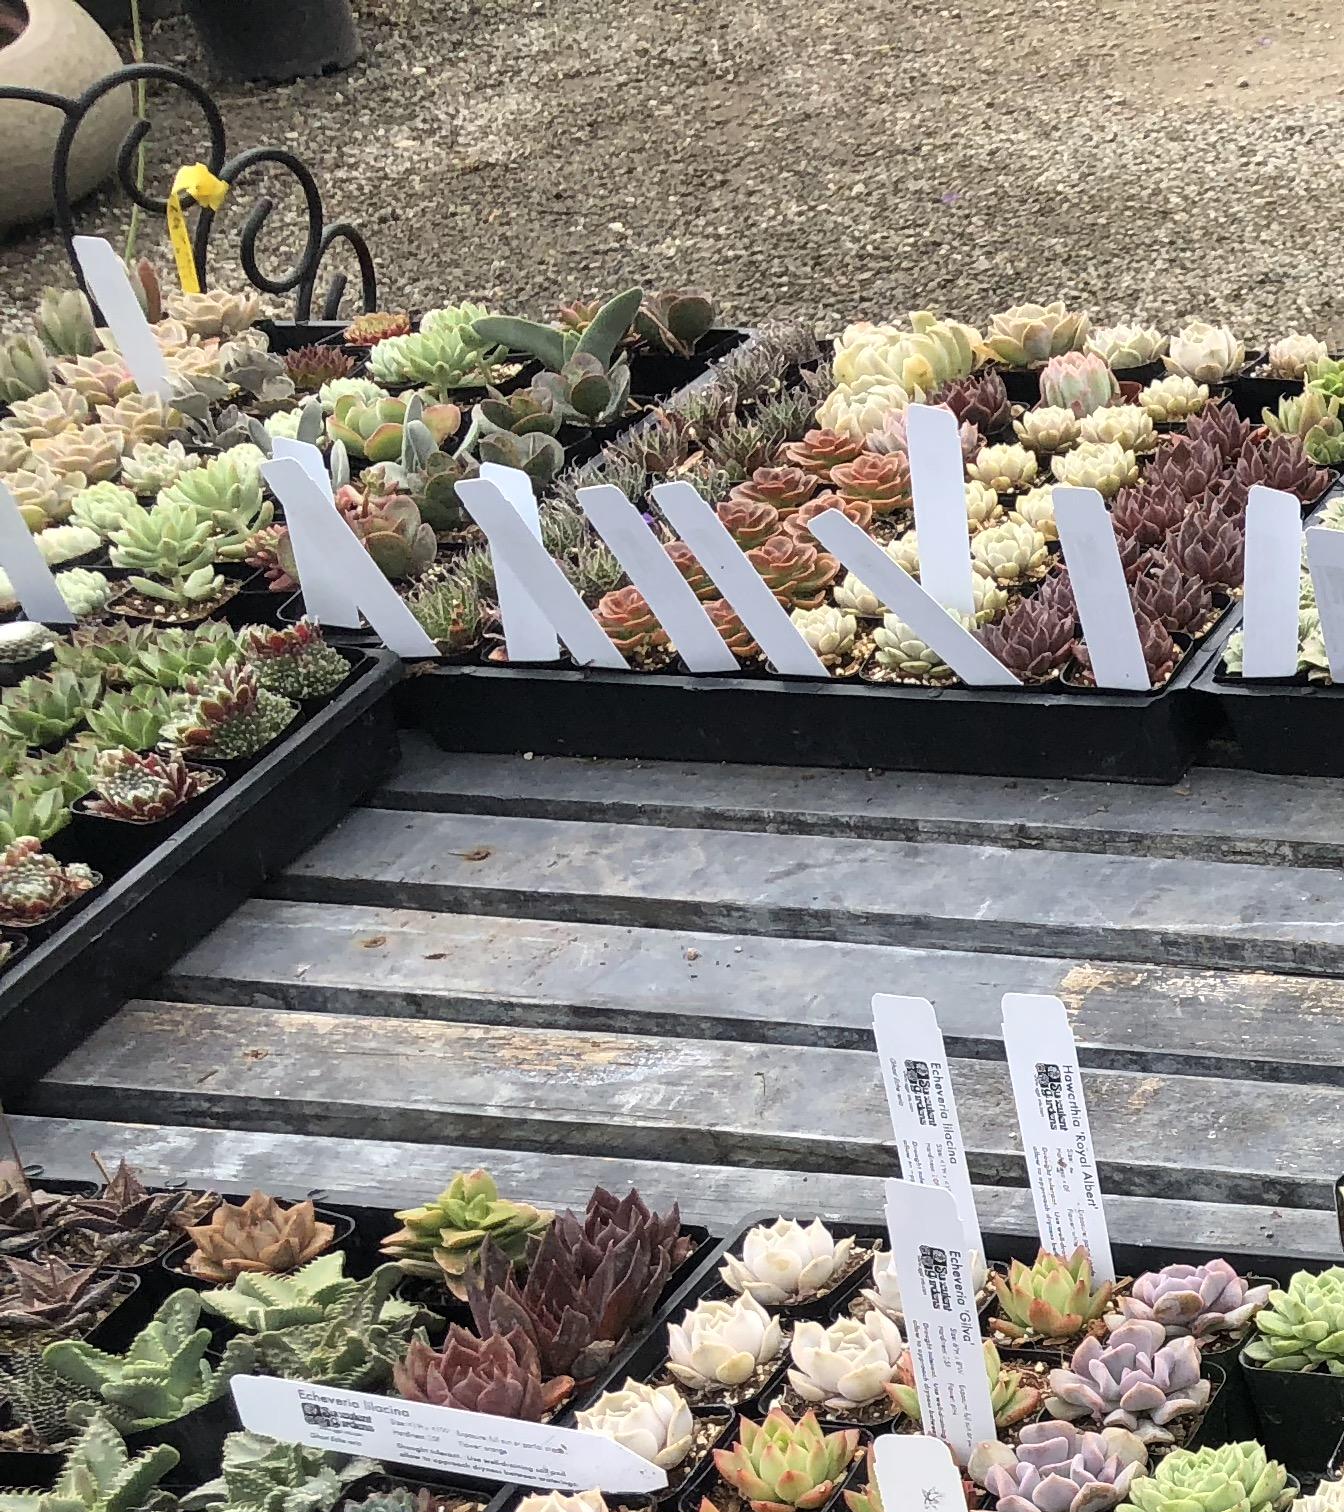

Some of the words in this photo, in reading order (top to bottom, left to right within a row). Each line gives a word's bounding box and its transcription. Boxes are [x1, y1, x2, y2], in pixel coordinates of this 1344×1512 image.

[930, 1062, 950, 1119] Echeveria
[942, 1123, 957, 1164] lilacina
[1074, 1131, 1092, 1168] 'Royal
[1081, 1171, 1099, 1210] Albert'
[948, 1250, 967, 1306] Echeveria
[959, 1309, 975, 1346] 'Gilva'
[297, 1388, 360, 1409] Echeveria
[363, 1399, 410, 1418] lilacina
